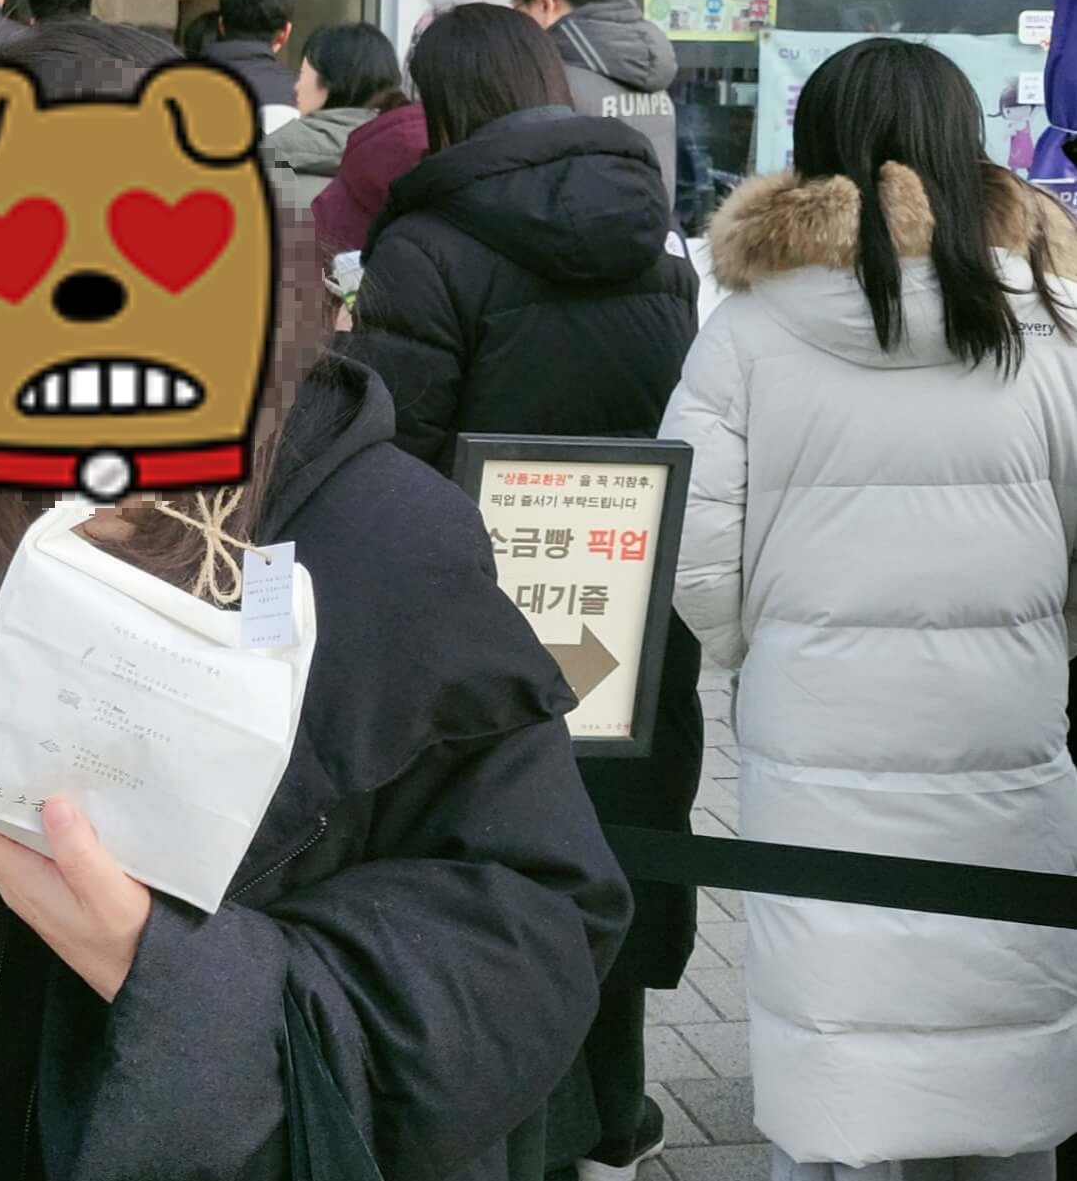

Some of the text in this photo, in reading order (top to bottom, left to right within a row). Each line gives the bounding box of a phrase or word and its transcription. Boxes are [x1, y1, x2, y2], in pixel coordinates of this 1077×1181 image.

[491, 494, 516, 507] 픽업
[562, 495, 637, 509] 부탁드립니다
[490, 527, 649, 561] 소금빵 픽업
